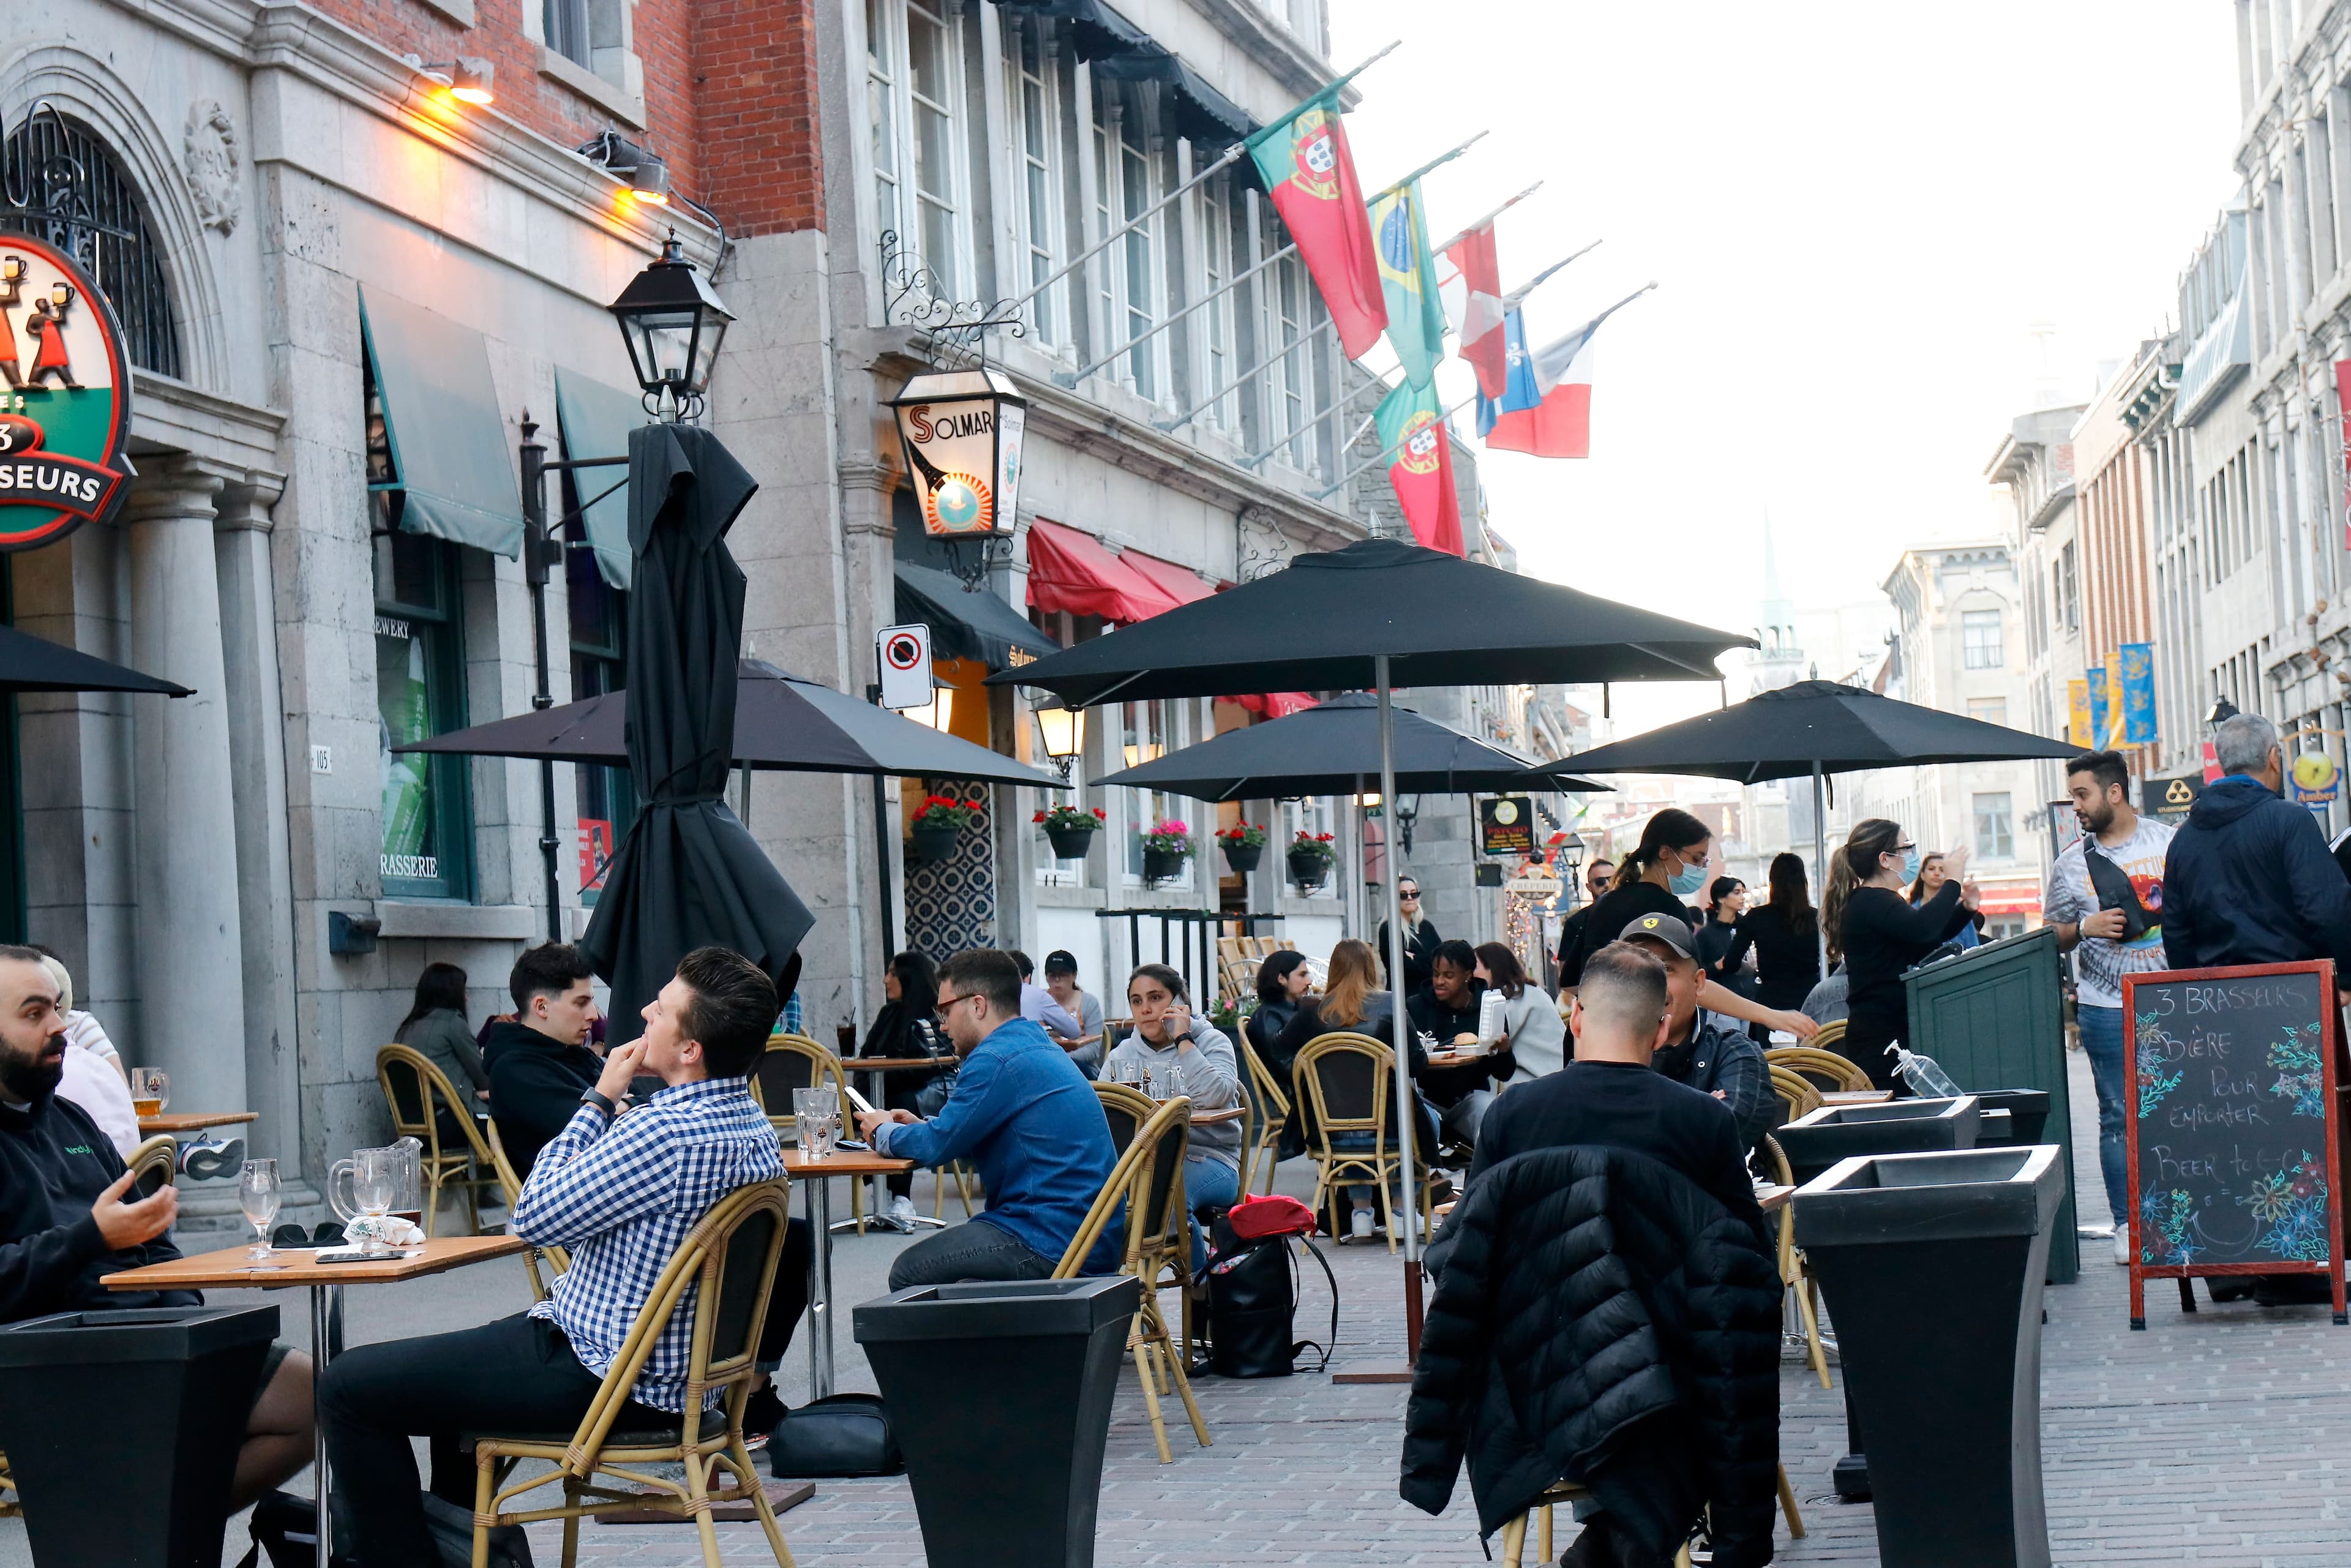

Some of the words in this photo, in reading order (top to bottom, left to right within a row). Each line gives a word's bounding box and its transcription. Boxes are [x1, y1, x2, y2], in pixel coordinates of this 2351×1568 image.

[910, 405, 994, 443] SOLMAR
[372, 616, 409, 639] EWERY
[317, 750, 328, 770] 105
[2297, 790, 2336, 802] Amber
[2155, 988, 2175, 1016] 3
[2186, 983, 2307, 1015] BRASSEURS
